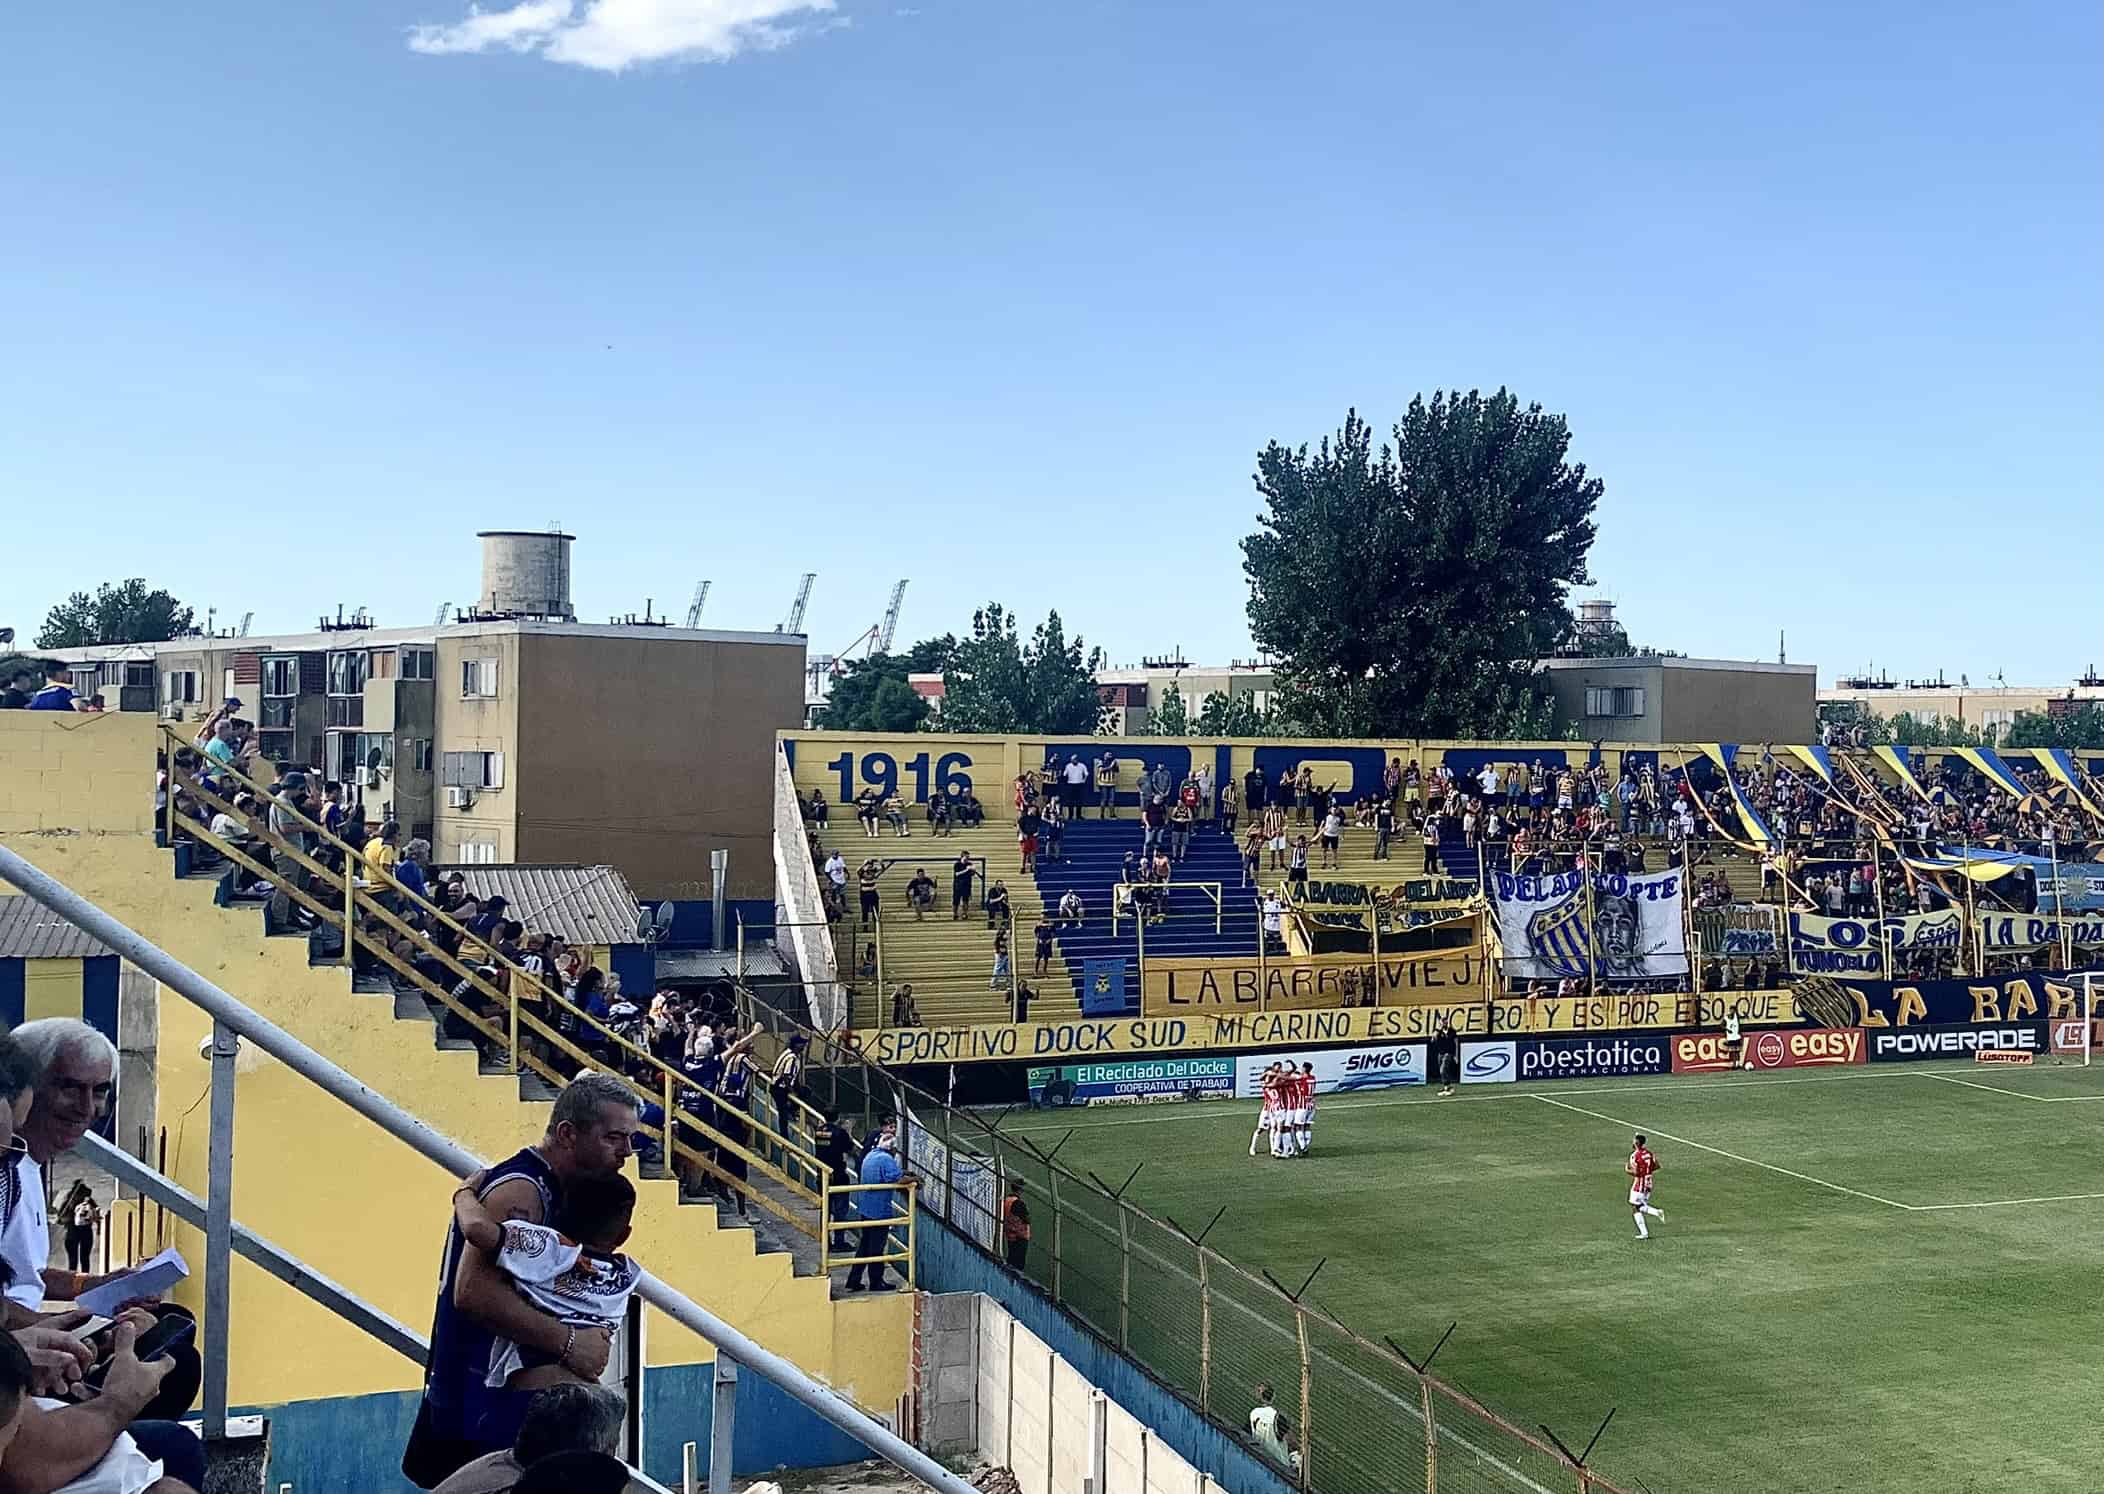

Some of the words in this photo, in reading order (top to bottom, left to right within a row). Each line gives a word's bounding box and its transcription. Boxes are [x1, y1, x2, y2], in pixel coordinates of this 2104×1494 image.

[828, 752, 973, 806] 1916
[1168, 970, 1221, 1004] LA
[1848, 984, 1928, 1027] LA
[879, 1028, 1017, 1063] SPORTIVO
[1035, 1023, 1117, 1054] DOCK
[1215, 1015, 1242, 1044] MI
[1252, 1012, 1350, 1042] CARIÑO
[1544, 1004, 1560, 1028] Y
[1618, 1000, 1659, 1025] POR
[1736, 995, 1779, 1020] QUE
[1523, 1041, 1660, 1075] pbestatica
[1790, 1032, 1860, 1062] easy
[1077, 1068, 1090, 1082] El
[1095, 1063, 1162, 1081] Reciclado
[1167, 1063, 1190, 1076] Del
[1193, 1061, 1228, 1075] Docke
[1114, 1081, 1175, 1094] COOPERATIVA
[1528, 1066, 1660, 1077] INTERNACIONAL
